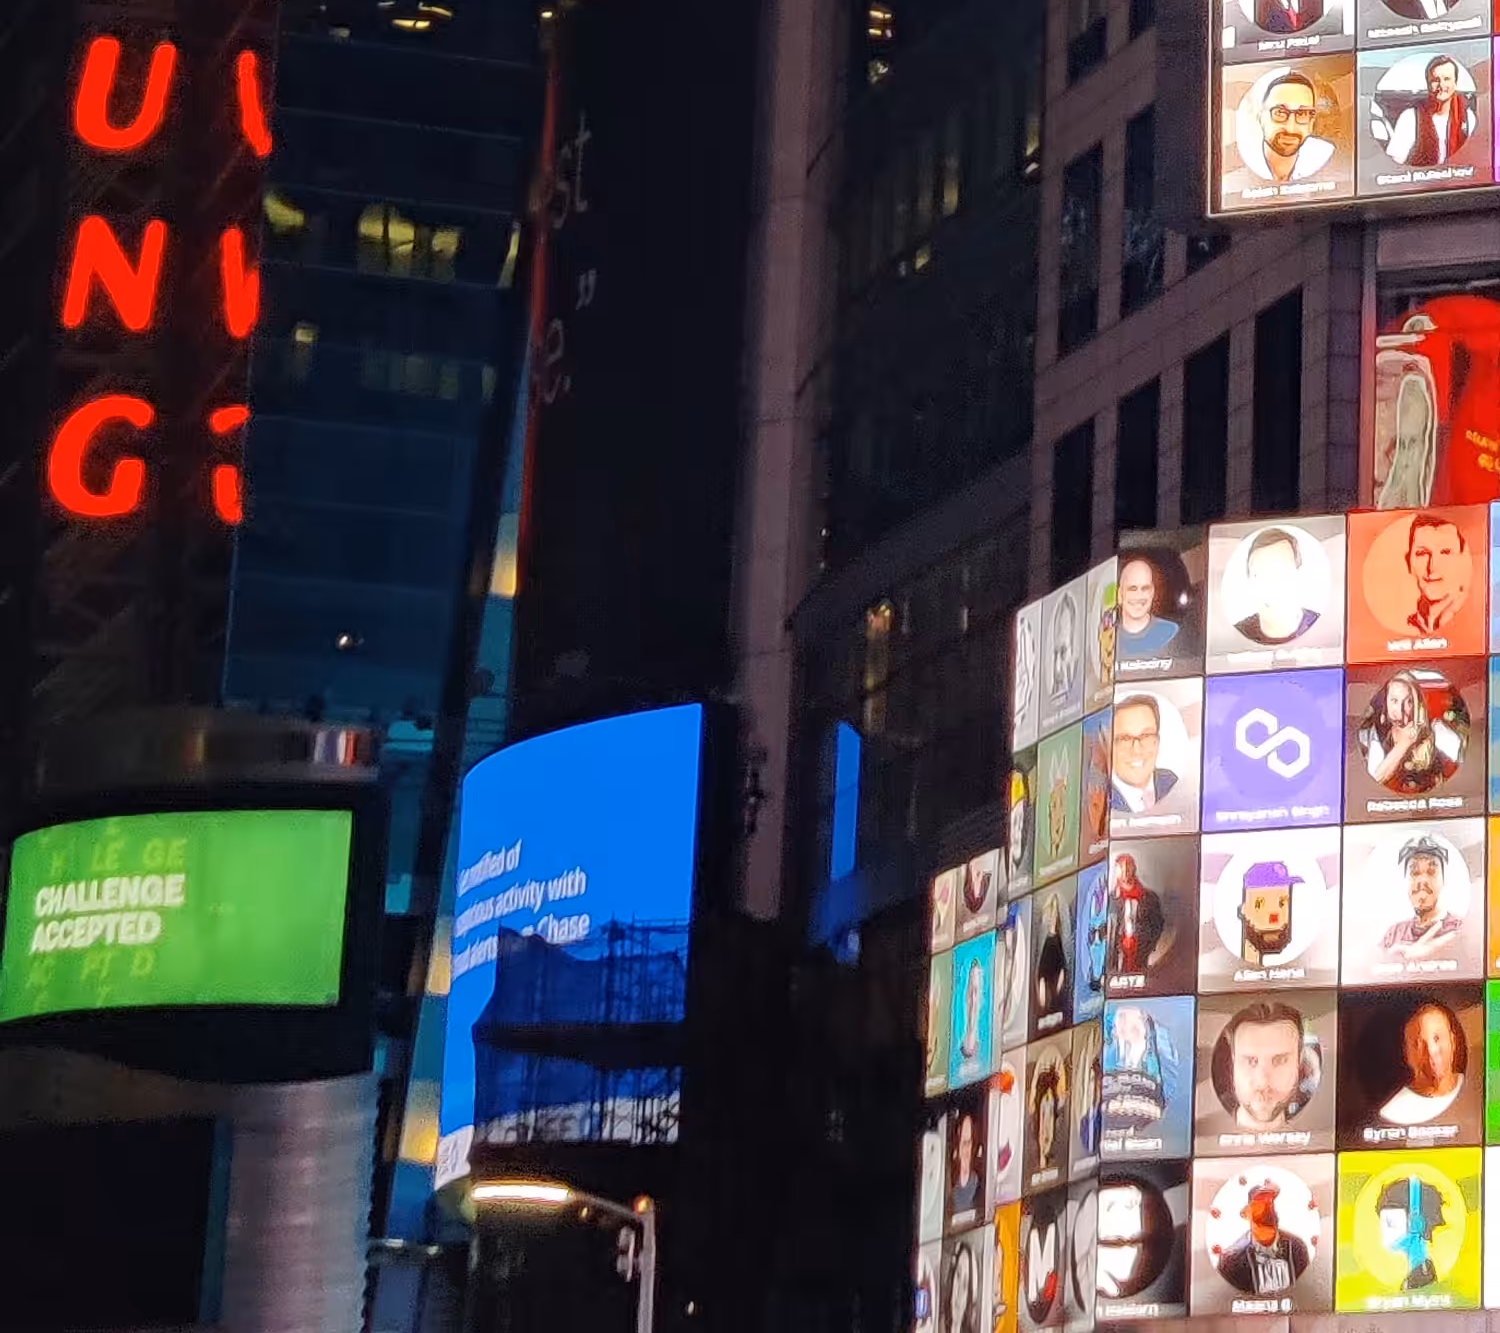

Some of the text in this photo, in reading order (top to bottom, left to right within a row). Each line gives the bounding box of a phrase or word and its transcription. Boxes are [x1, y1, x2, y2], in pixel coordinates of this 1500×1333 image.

[35, 873, 187, 918] CHALLENGE
[495, 879, 546, 916] activity
[547, 865, 588, 902] with
[29, 909, 163, 955] ACCEPTED
